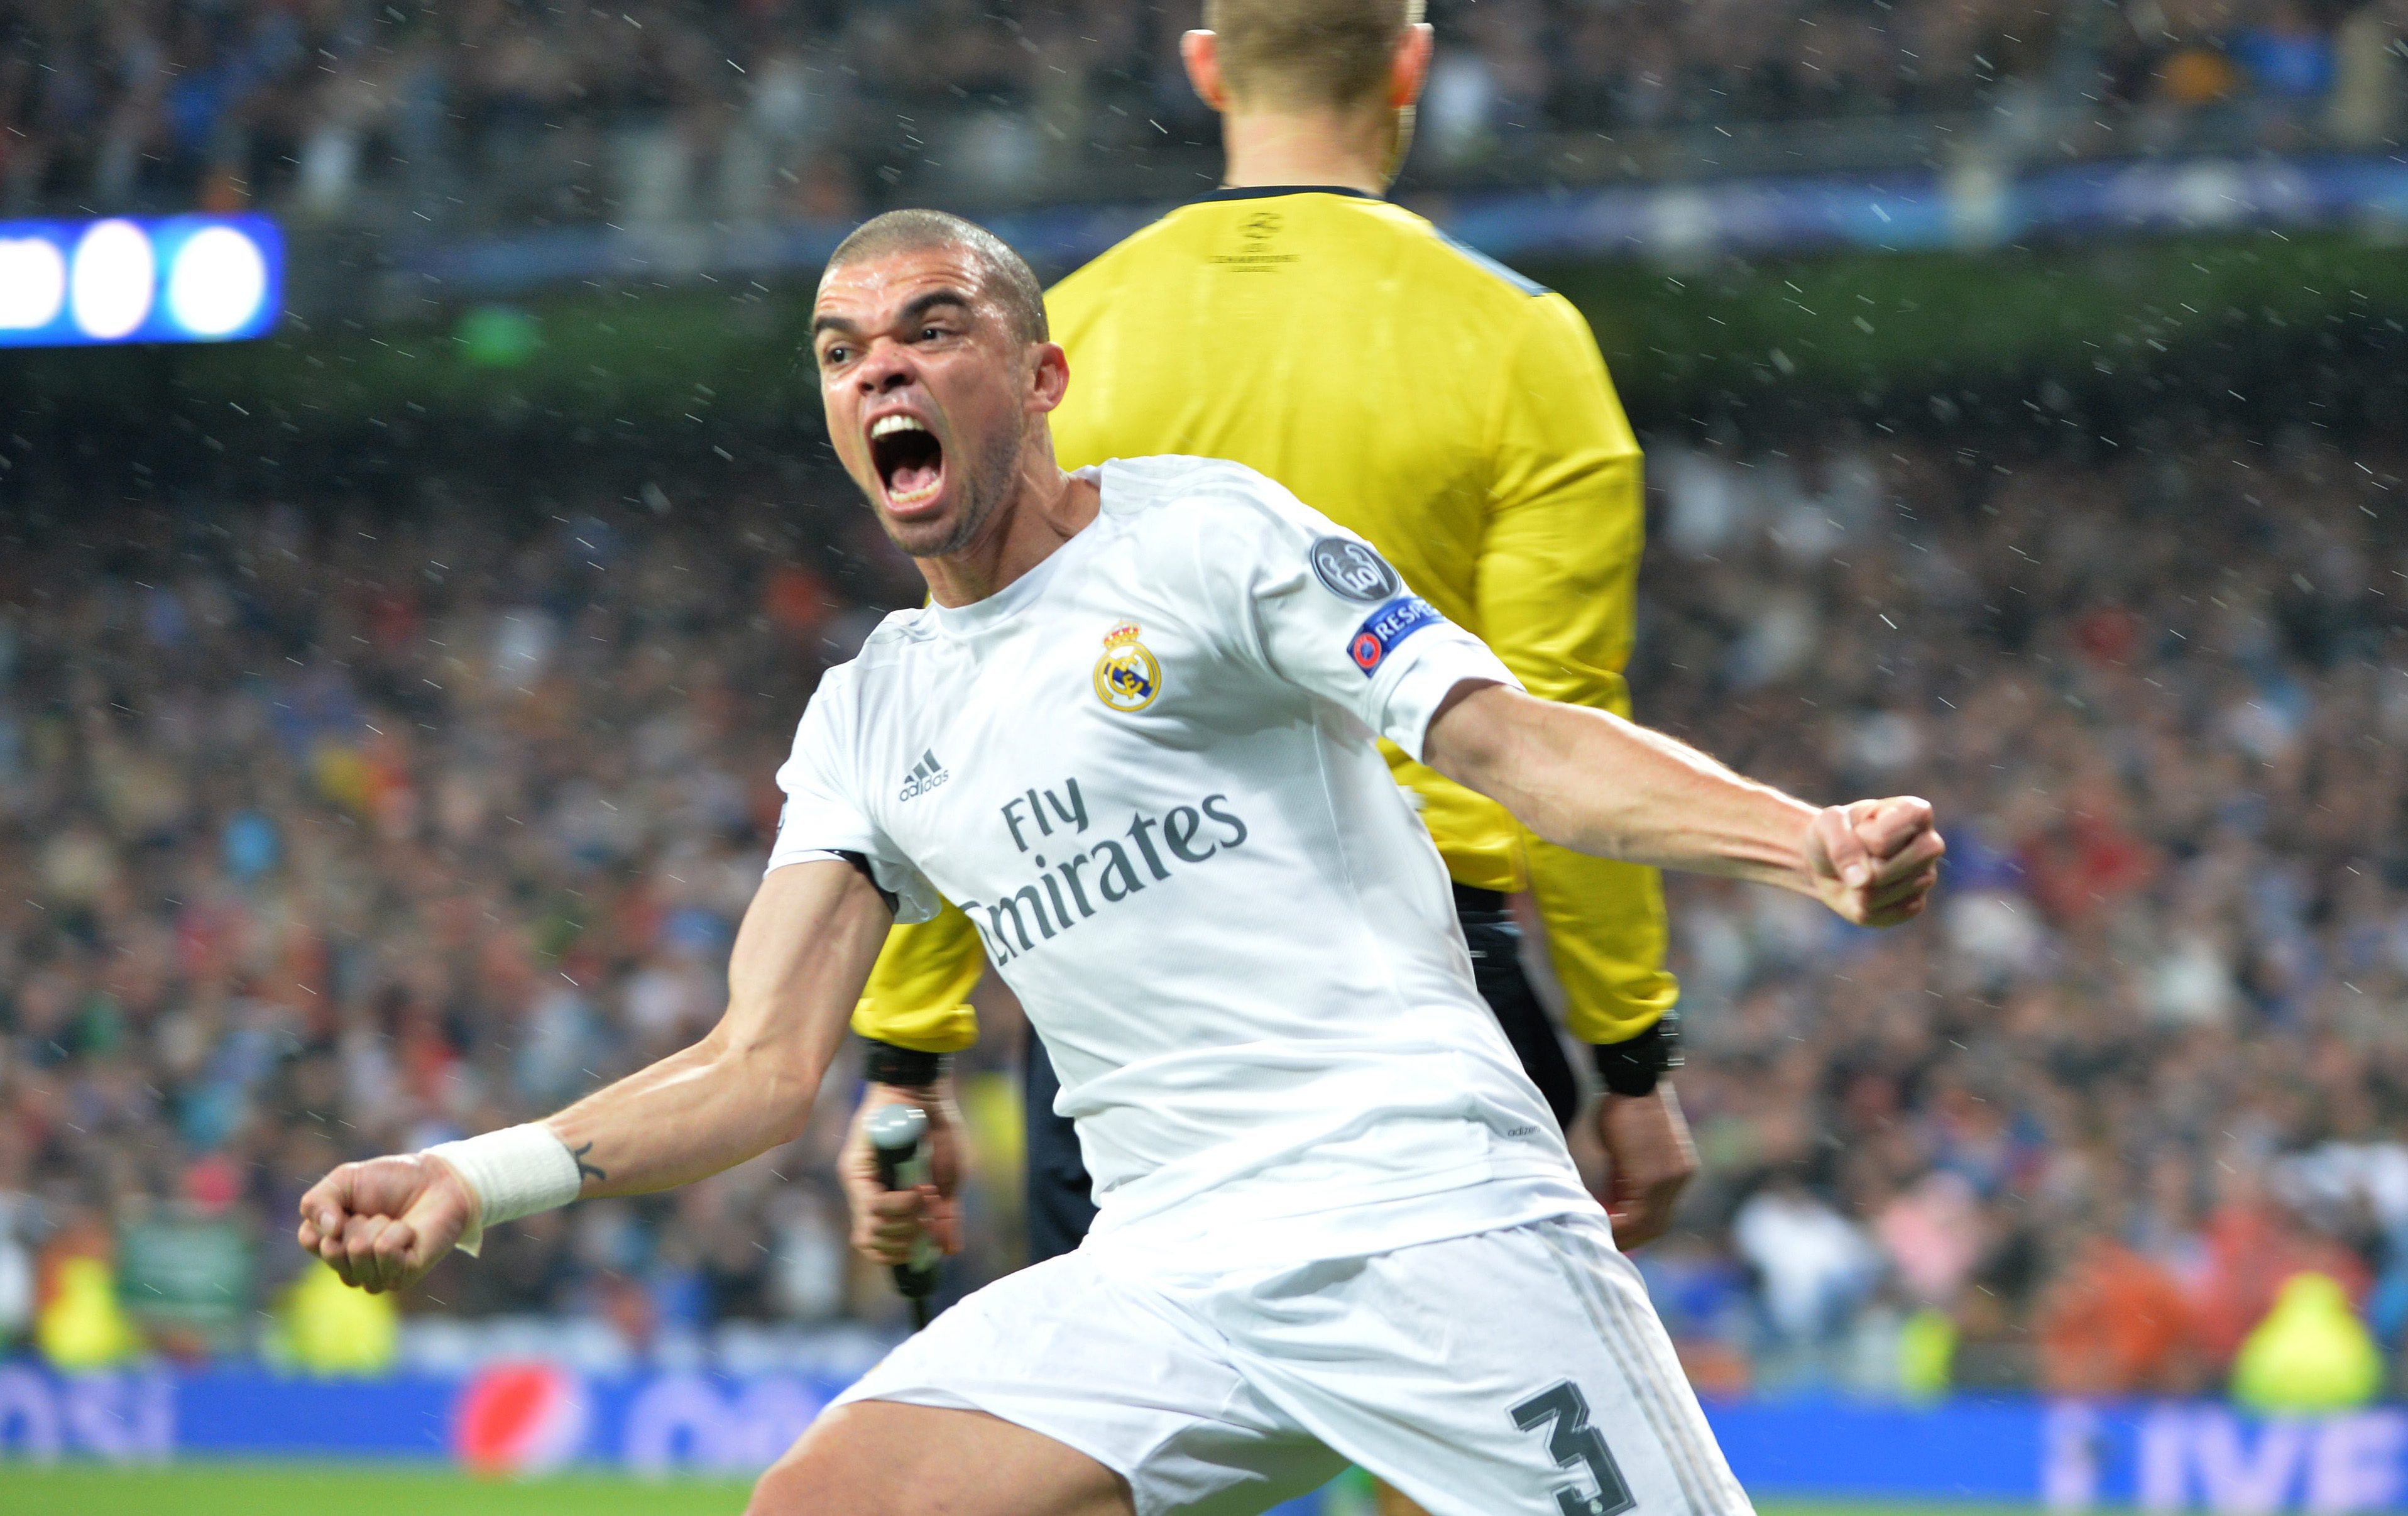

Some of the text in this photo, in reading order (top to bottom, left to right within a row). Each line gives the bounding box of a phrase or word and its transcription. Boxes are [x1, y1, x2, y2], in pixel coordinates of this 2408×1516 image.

[1346, 567, 1379, 591] 10
[899, 769, 949, 801] adidas
[1000, 777, 1089, 852] Fly
[1506, 1378, 1637, 1516] 3
